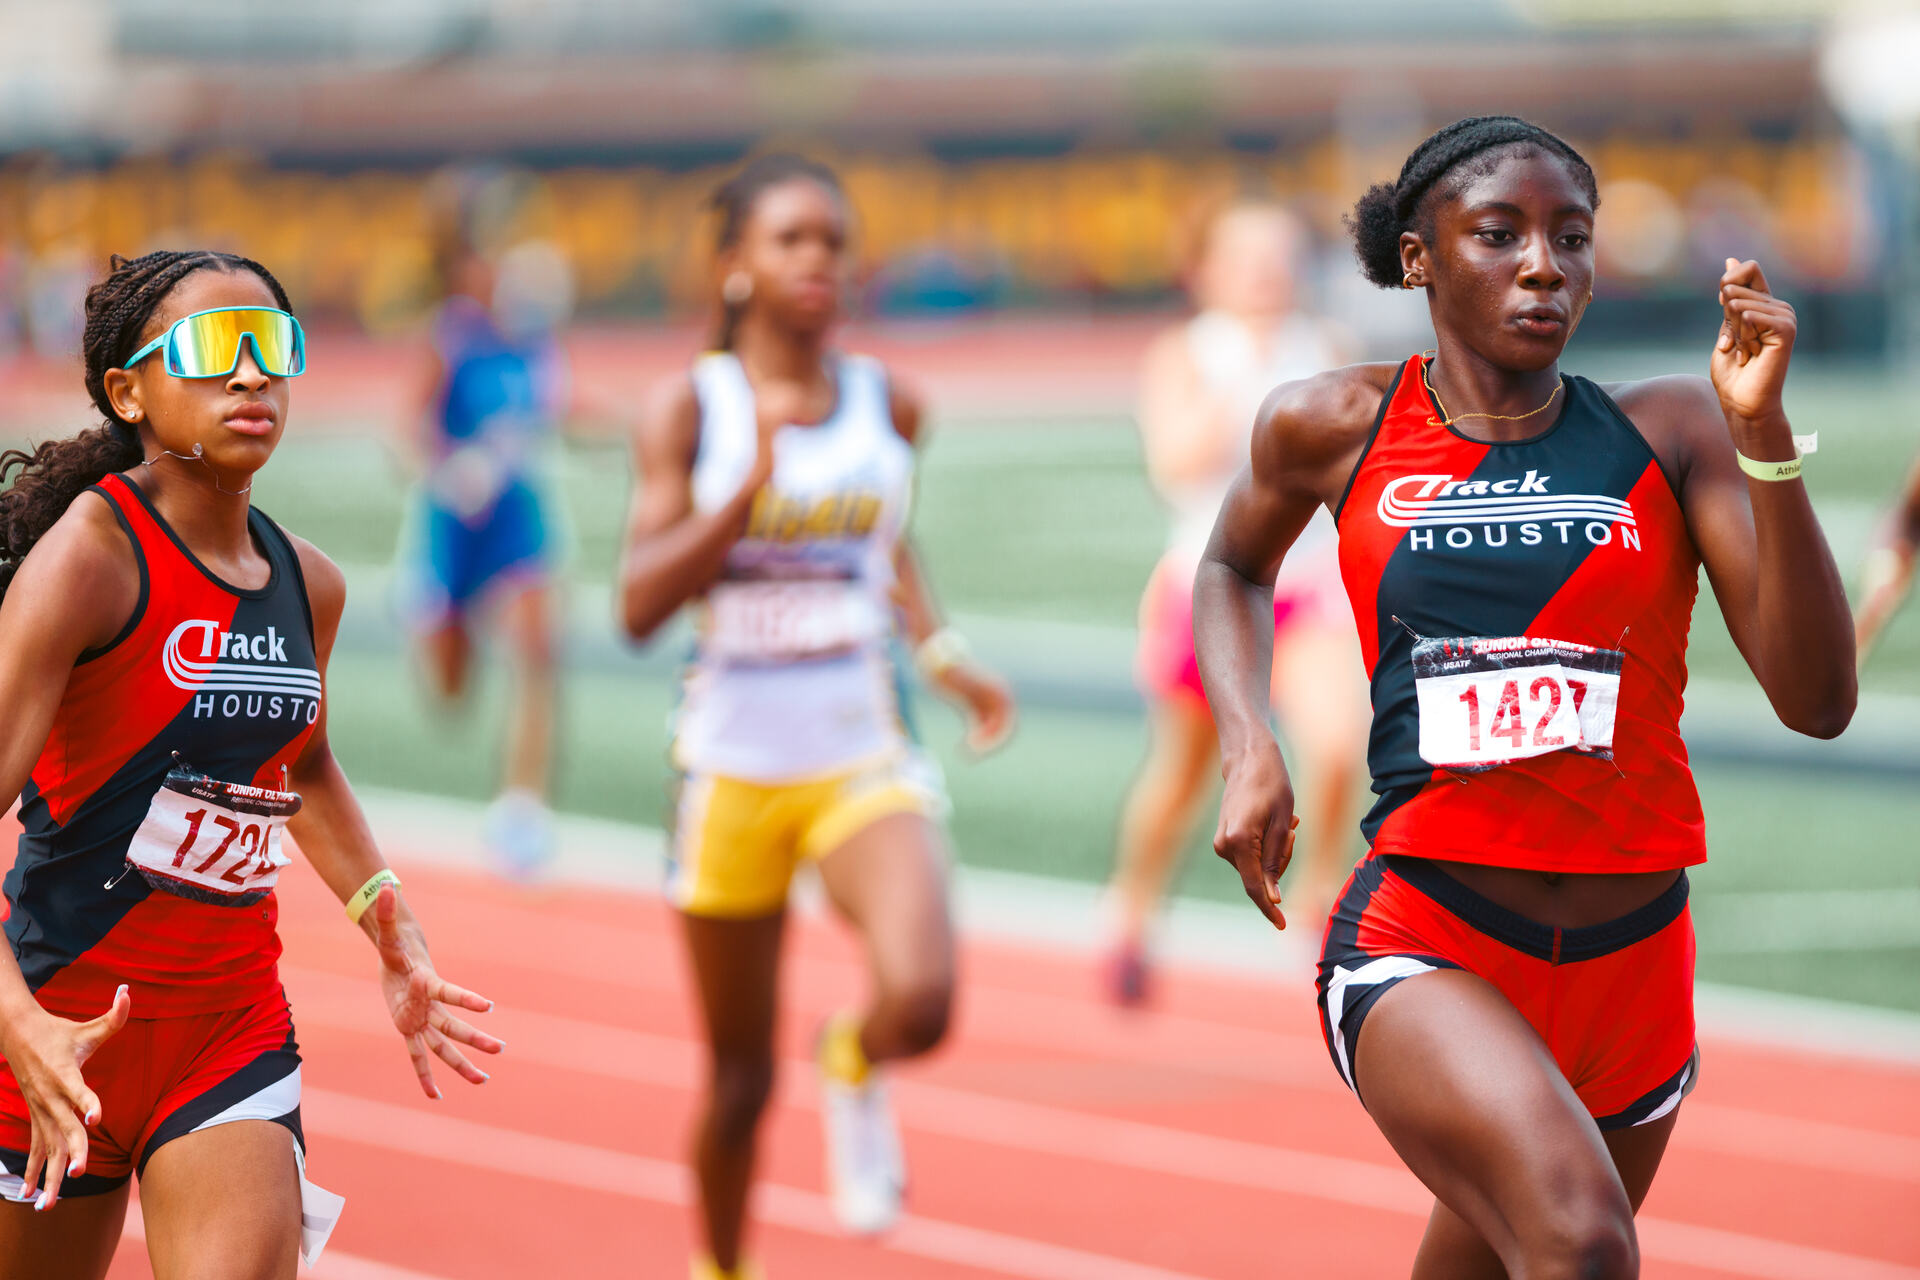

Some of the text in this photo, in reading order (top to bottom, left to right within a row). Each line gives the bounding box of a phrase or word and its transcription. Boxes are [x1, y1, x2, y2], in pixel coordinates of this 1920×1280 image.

[1388, 469, 1551, 498] Track
[1410, 519, 1642, 552] HOUSTON
[174, 619, 289, 663] Track
[1486, 649, 1523, 661] REGIONAL
[1443, 659, 1471, 670] USATF
[192, 787, 217, 799] USATF
[226, 783, 262, 798] JUNIOR
